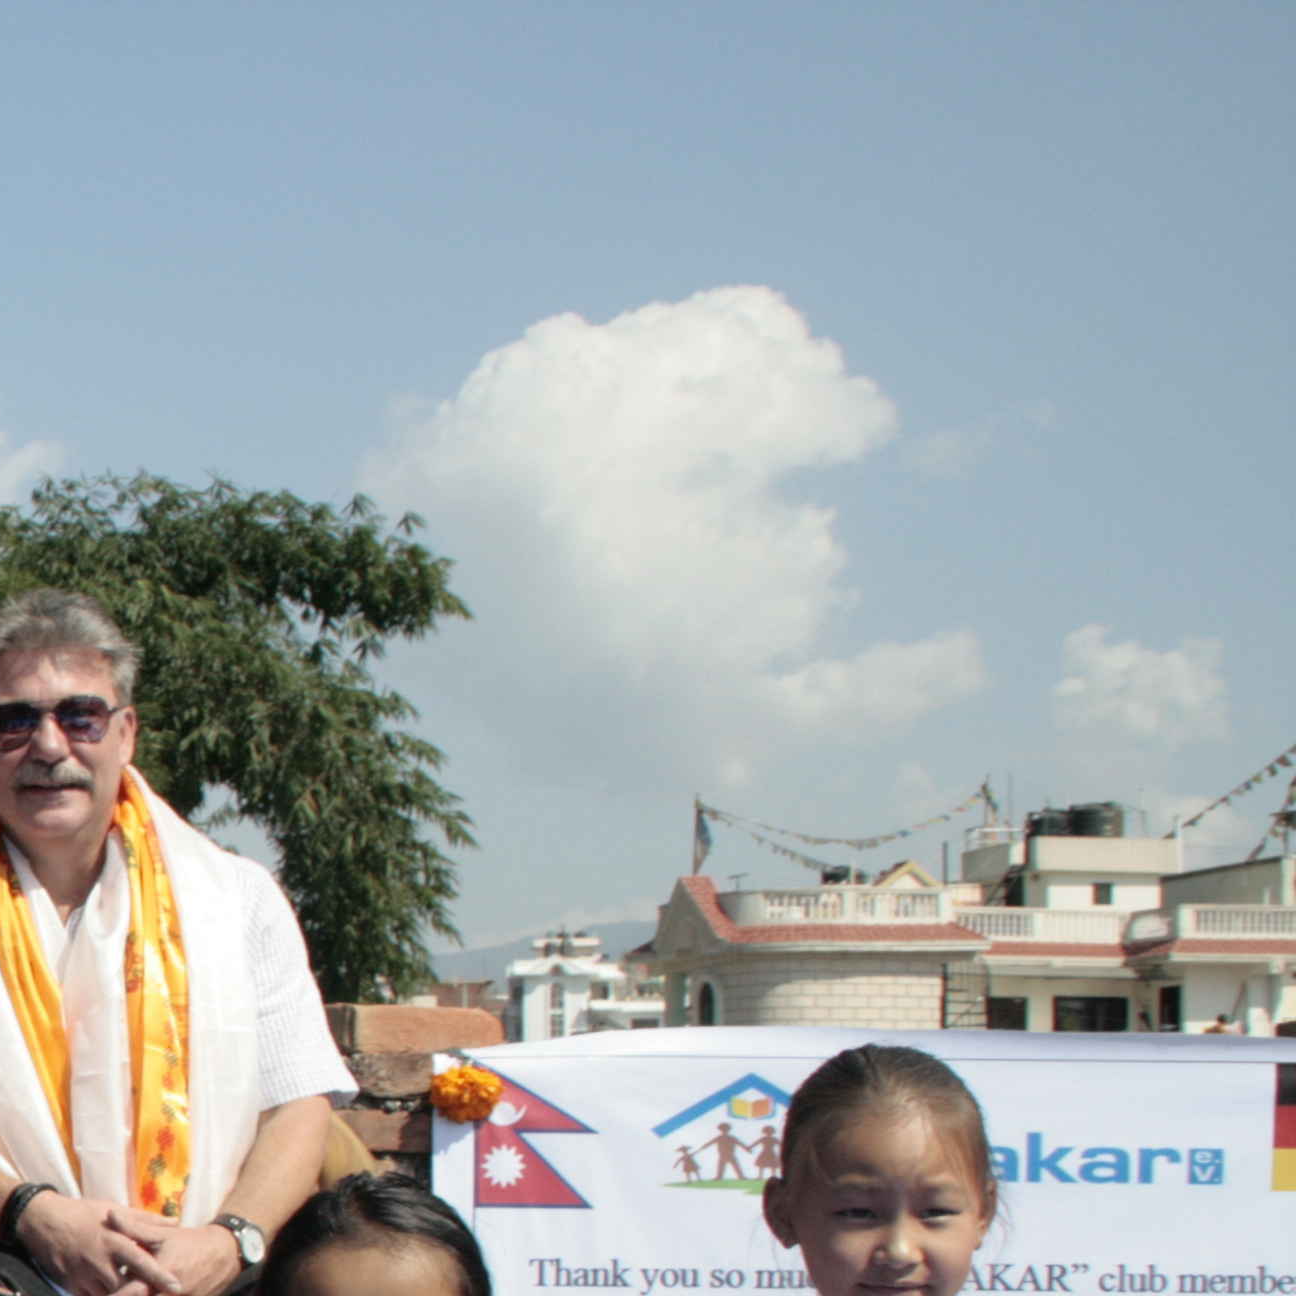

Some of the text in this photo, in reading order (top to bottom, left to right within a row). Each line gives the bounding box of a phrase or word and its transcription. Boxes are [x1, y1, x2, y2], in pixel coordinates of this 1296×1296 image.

[989, 1132, 1182, 1184] akar
[528, 1258, 630, 1288] Thank
[639, 1268, 700, 1296] you
[709, 1268, 745, 1289] so
[959, 1263, 1090, 1293] AKAR”
[1098, 1263, 1168, 1293] club
[1176, 1266, 1296, 1295] membe
